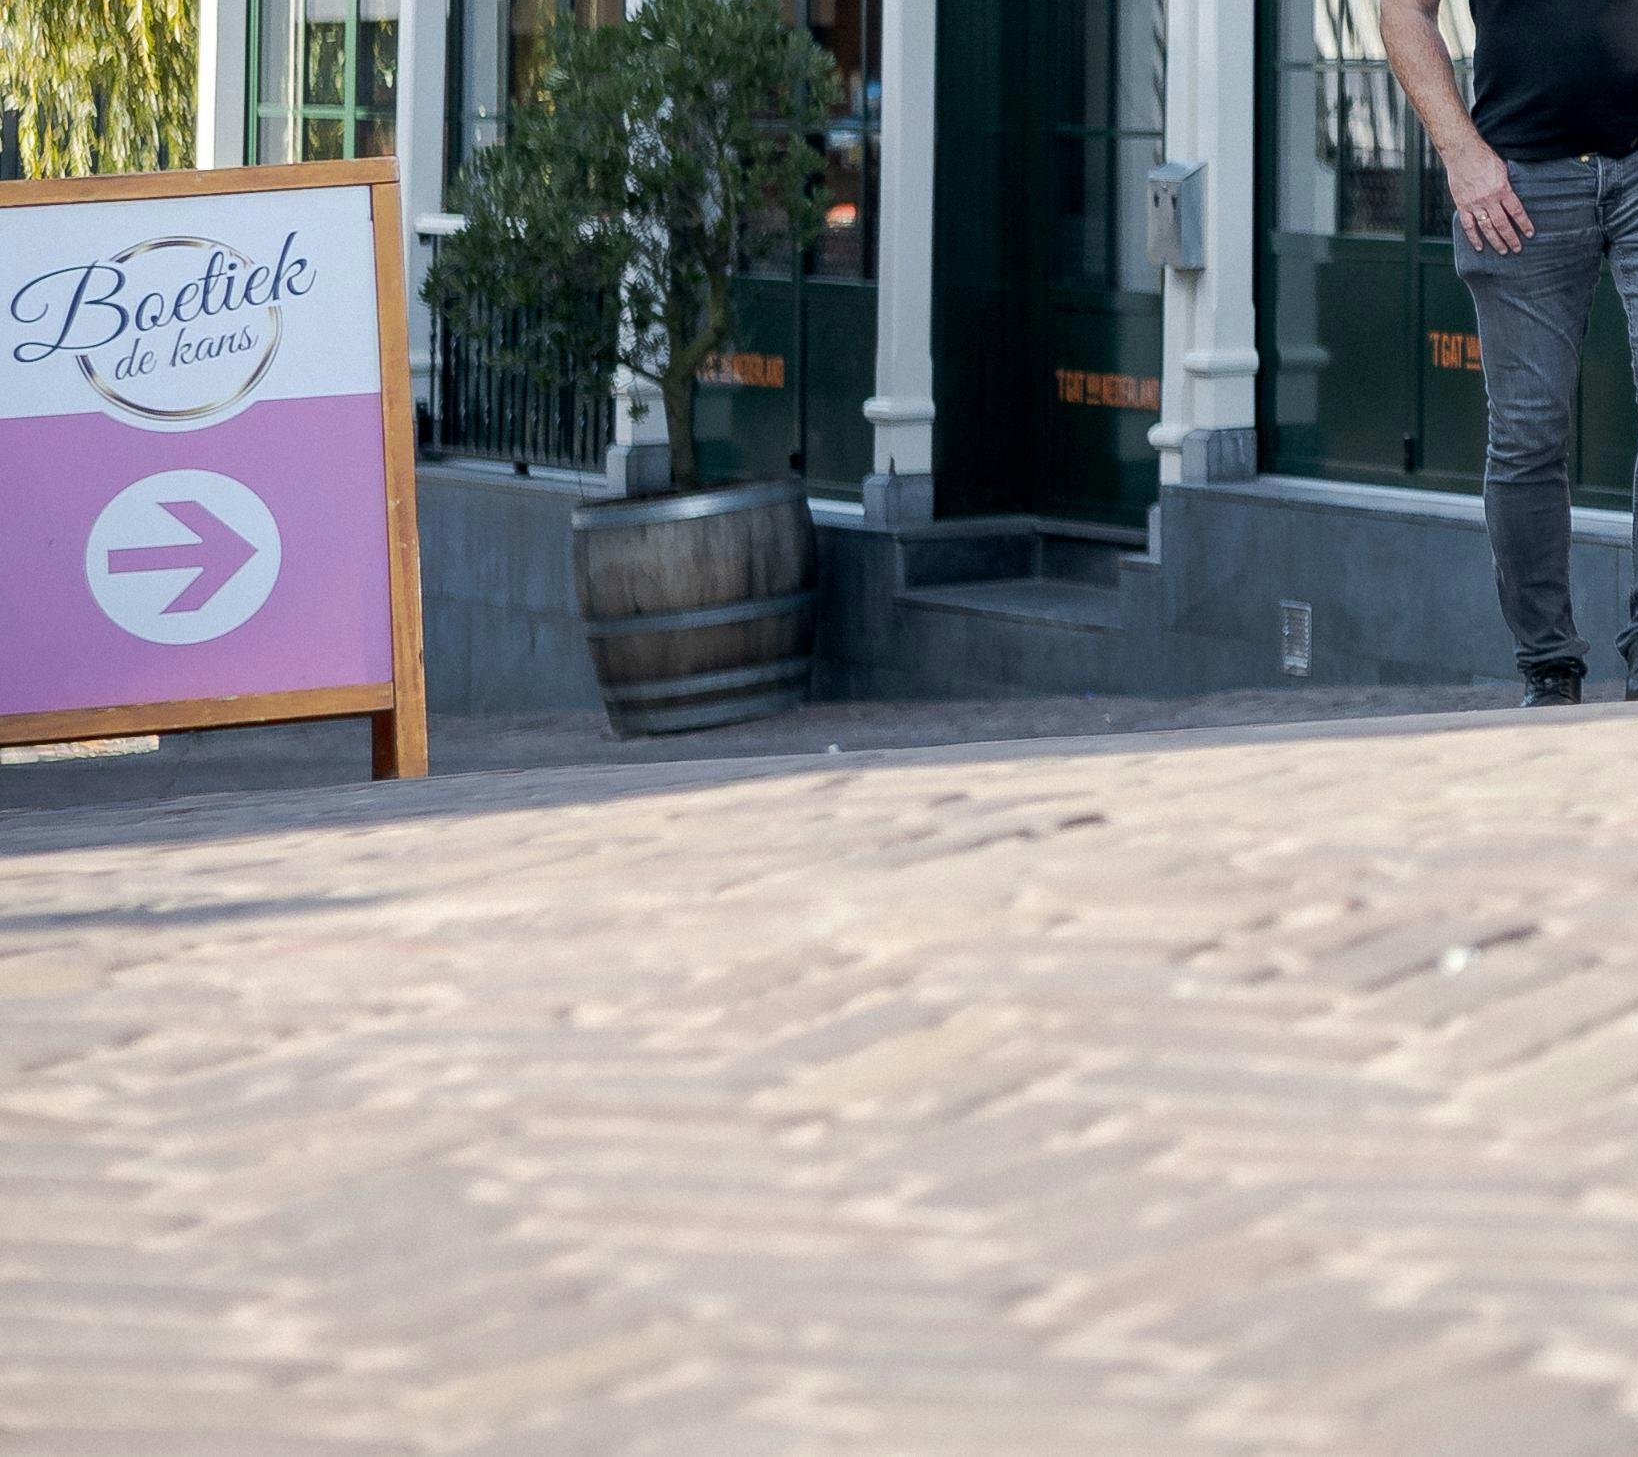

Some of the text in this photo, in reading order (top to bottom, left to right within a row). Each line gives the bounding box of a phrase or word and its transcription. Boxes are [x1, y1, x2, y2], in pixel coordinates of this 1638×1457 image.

[10, 231, 317, 363] Boetiek
[115, 325, 260, 381] de kans
